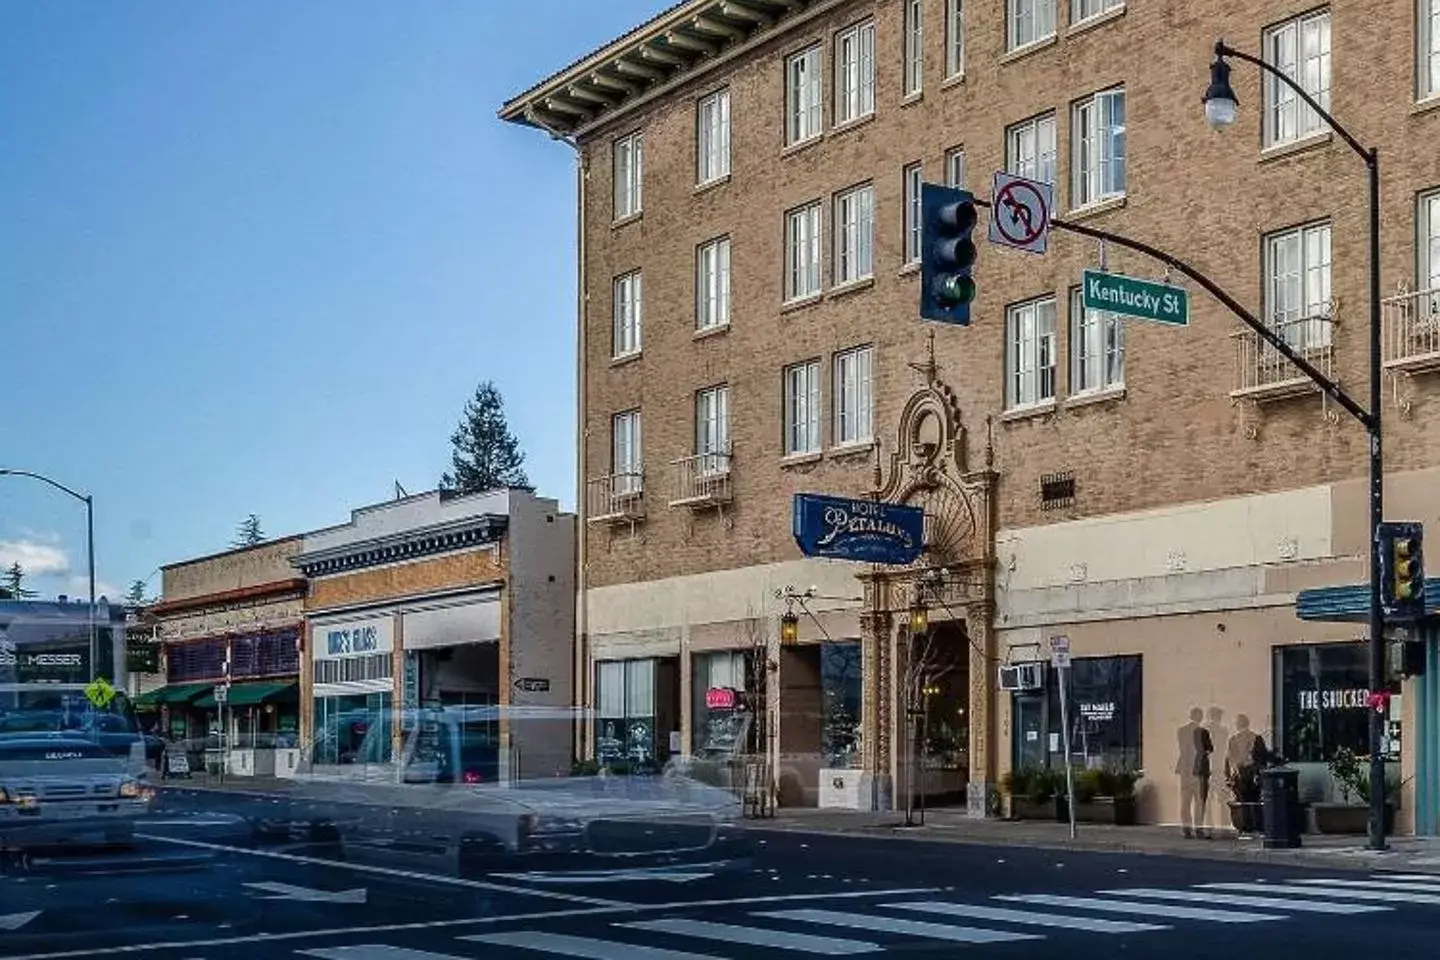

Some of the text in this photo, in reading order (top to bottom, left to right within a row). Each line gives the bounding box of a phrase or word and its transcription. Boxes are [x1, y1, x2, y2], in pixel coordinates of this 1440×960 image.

[1090, 278, 1179, 315] Kentucky St
[851, 501, 887, 517] HOTEL
[28, 654, 81, 665] MESSER
[1300, 690, 1319, 709] THE
[1322, 689, 1371, 708] SHUCKER
